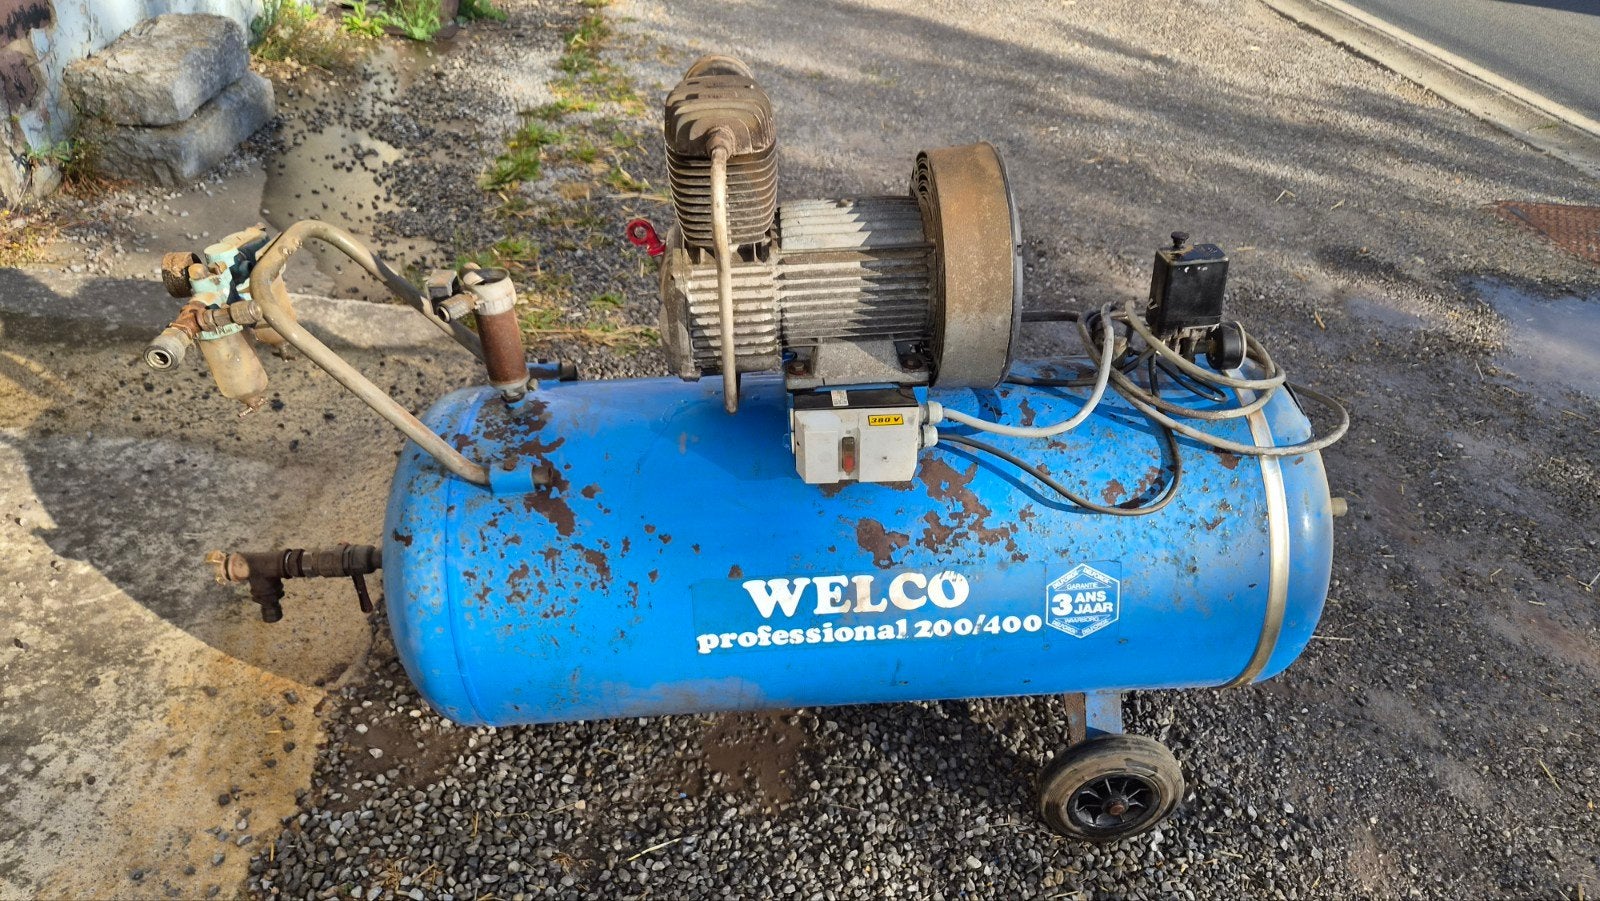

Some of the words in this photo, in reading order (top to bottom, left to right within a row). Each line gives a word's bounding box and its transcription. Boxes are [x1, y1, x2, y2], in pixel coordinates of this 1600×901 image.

[743, 571, 970, 619] WELCO
[1051, 593, 1073, 616] 3
[1074, 591, 1107, 603] ANS
[1074, 602, 1114, 615] JAAR
[696, 618, 907, 655] professional
[914, 614, 1043, 641] 200/400
